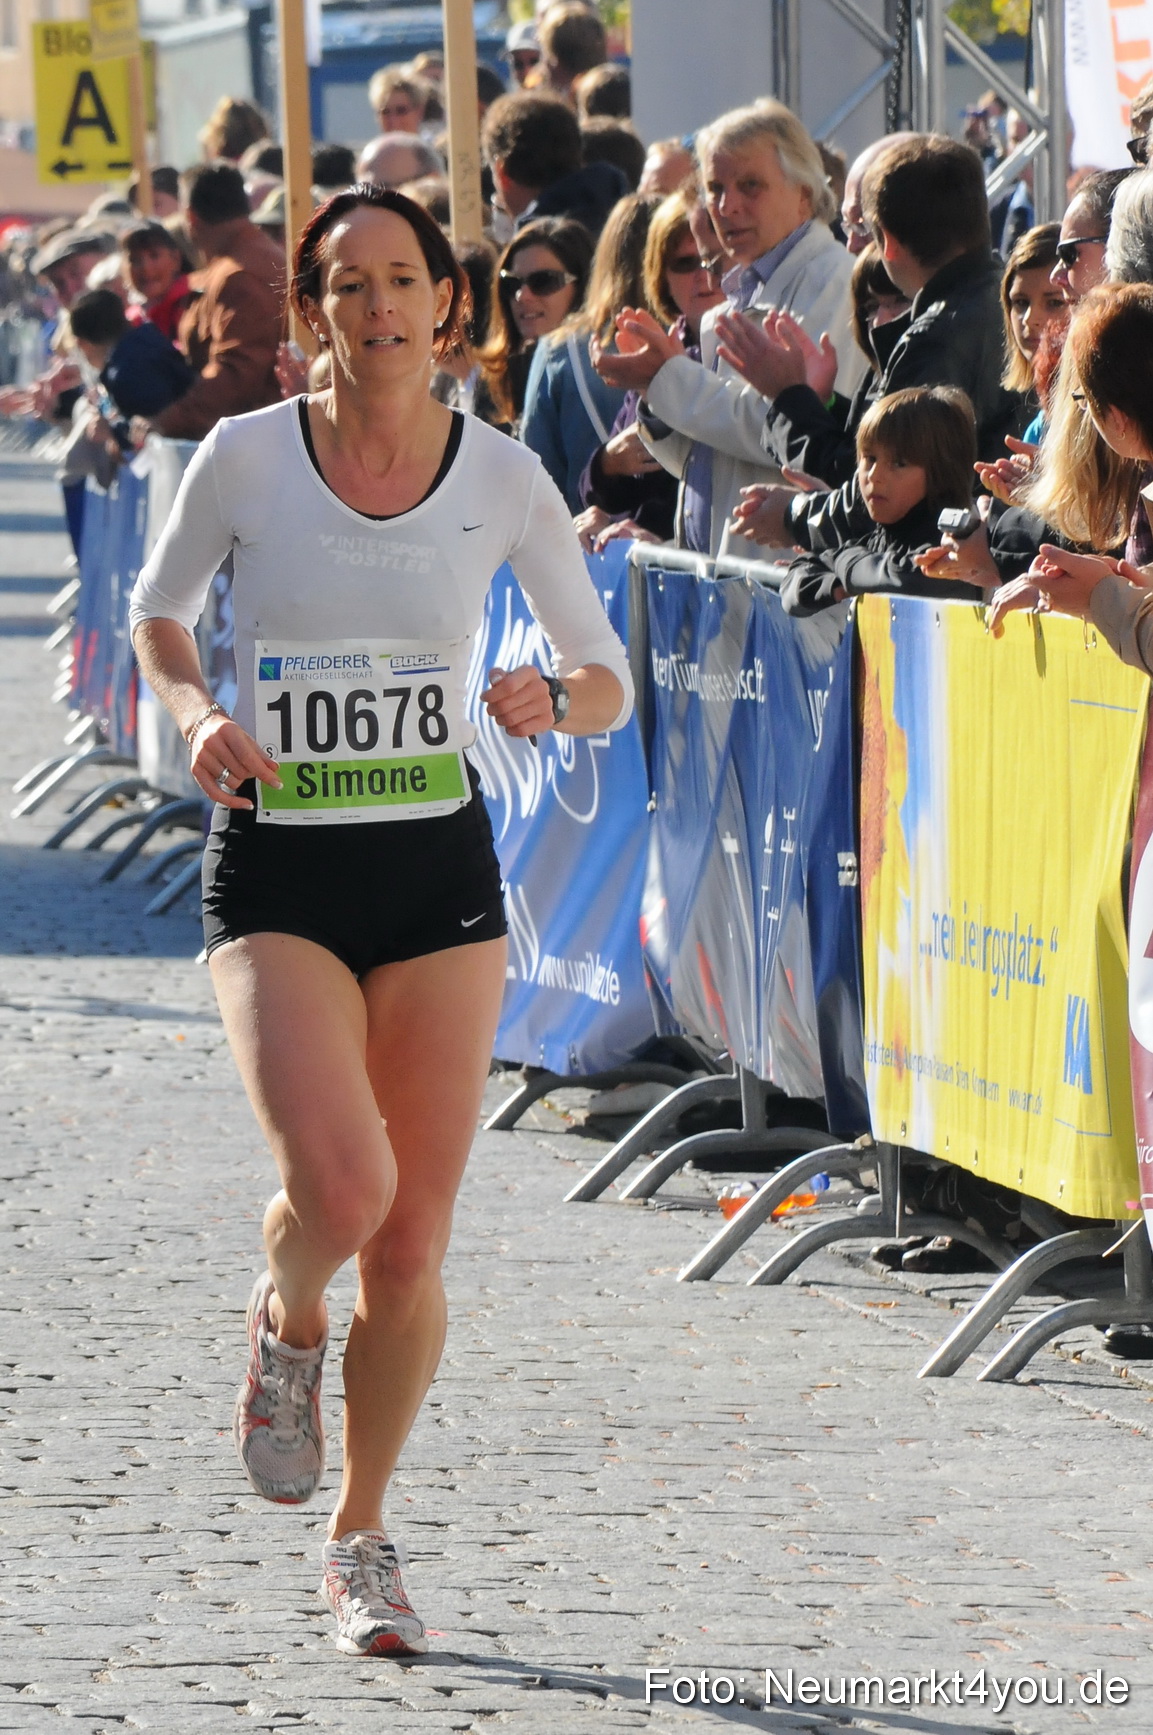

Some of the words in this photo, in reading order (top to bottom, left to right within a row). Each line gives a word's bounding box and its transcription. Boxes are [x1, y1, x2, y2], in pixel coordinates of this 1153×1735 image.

[61, 70, 118, 146] A
[284, 654, 372, 671] PFLEIDERER
[390, 653, 439, 669] BOCK
[284, 671, 373, 681] AKTIENGESELLSCHAFT
[266, 683, 449, 754] 10678
[296, 762, 428, 799] Simone
